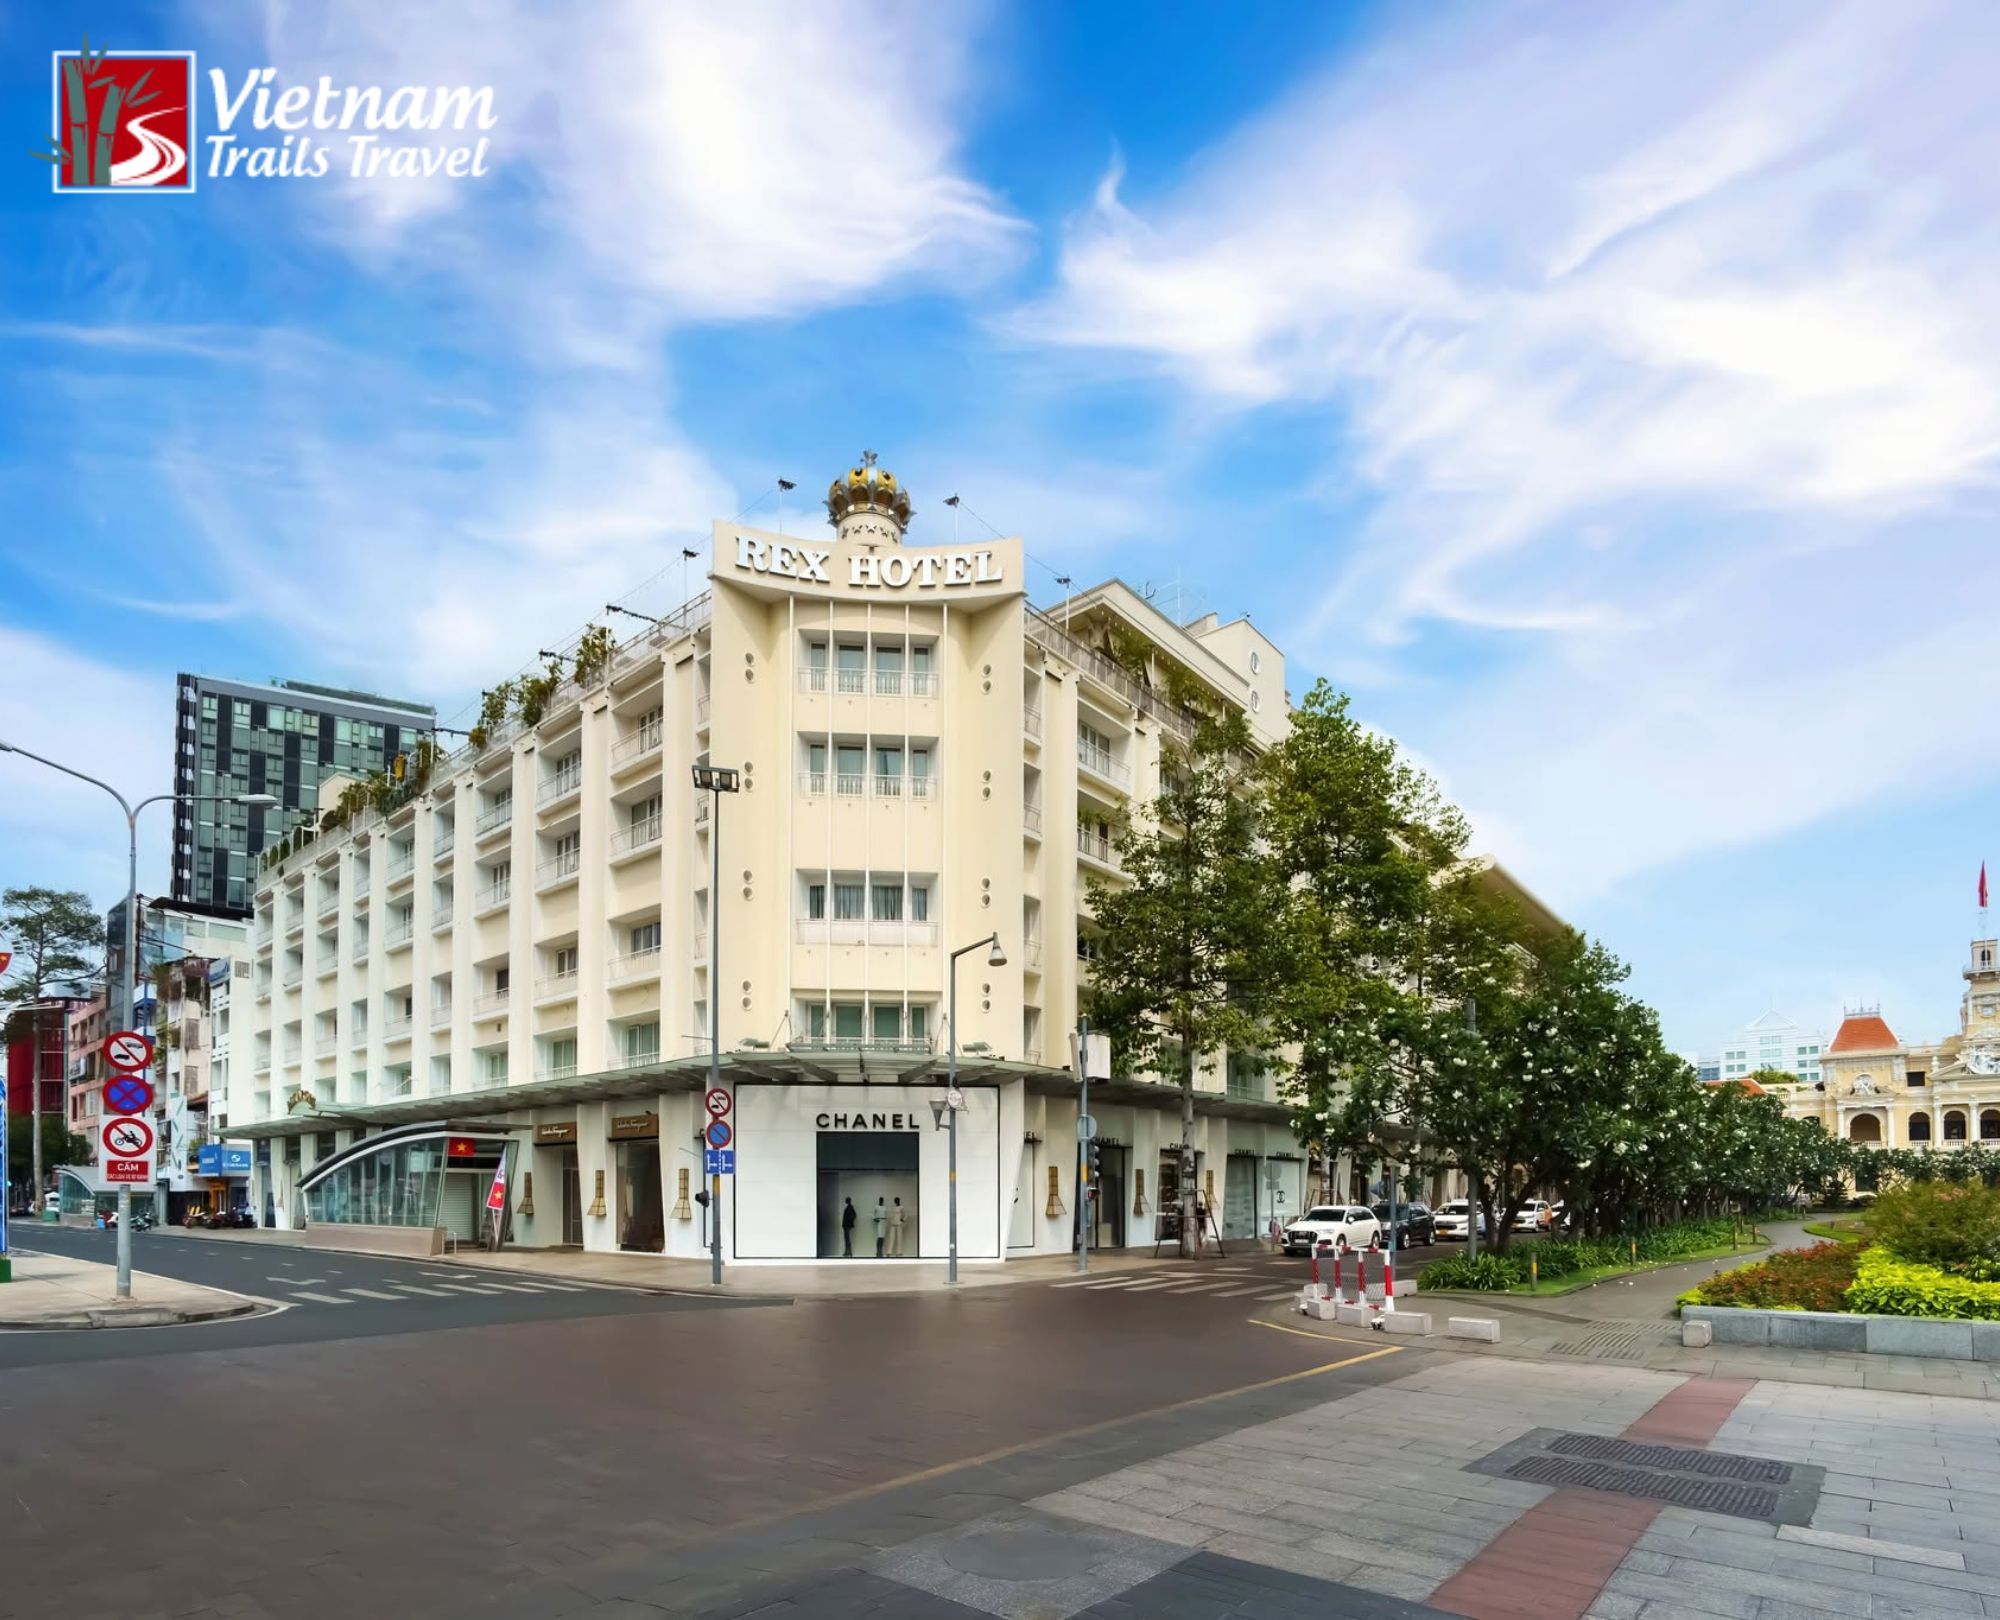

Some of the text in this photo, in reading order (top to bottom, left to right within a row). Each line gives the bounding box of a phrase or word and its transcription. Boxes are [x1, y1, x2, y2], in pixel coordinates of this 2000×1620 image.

[735, 535, 1004, 589] REX HOTEL
[816, 1113, 921, 1129] CHANEL
